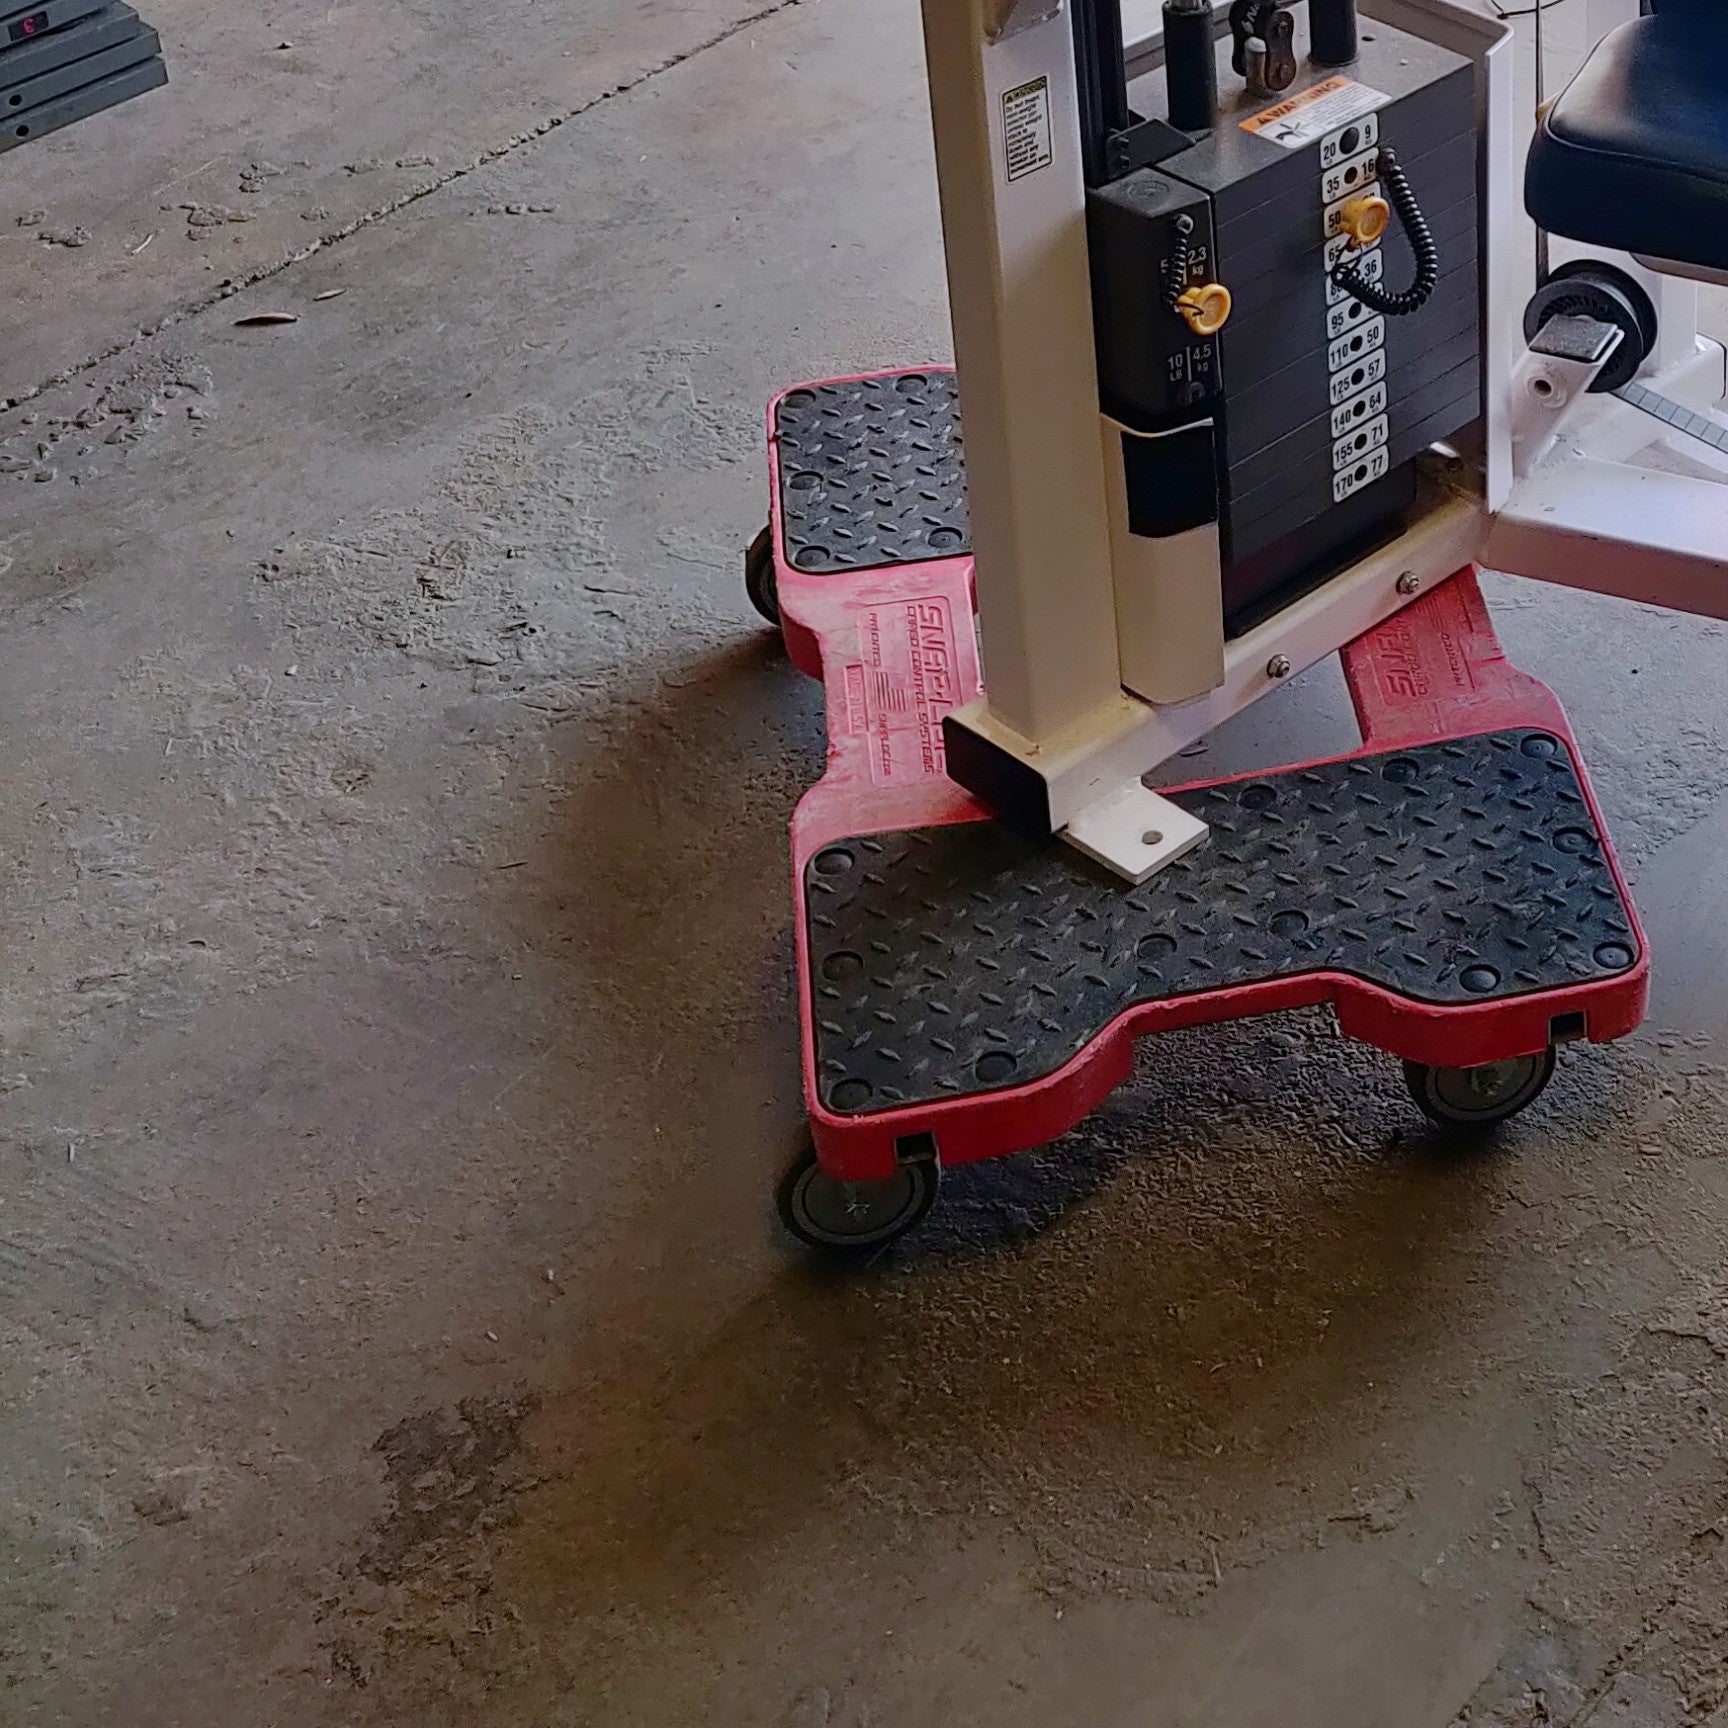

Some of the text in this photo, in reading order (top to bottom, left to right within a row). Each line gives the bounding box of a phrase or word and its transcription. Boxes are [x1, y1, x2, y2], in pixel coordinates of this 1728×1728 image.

[1323, 124, 1372, 162] 20 9
[1326, 158, 1375, 195] 35 16
[1328, 210, 1342, 229] 50
[1188, 246, 1207, 265] 2.3
[1364, 259, 1378, 278] 36
[1330, 312, 1345, 330] 95
[1168, 343, 1212, 372] 10 4.5
[1330, 343, 1349, 365] 110
[1366, 326, 1380, 343] 50
[1170, 369, 1183, 382] LB
[1332, 358, 1381, 398] 125 57
[1333, 390, 1382, 431] 140 64
[1335, 423, 1384, 463] 155 71
[1335, 454, 1384, 496] 170 77
[907, 605, 935, 774] CARGO CONTROL SYSTEMS
